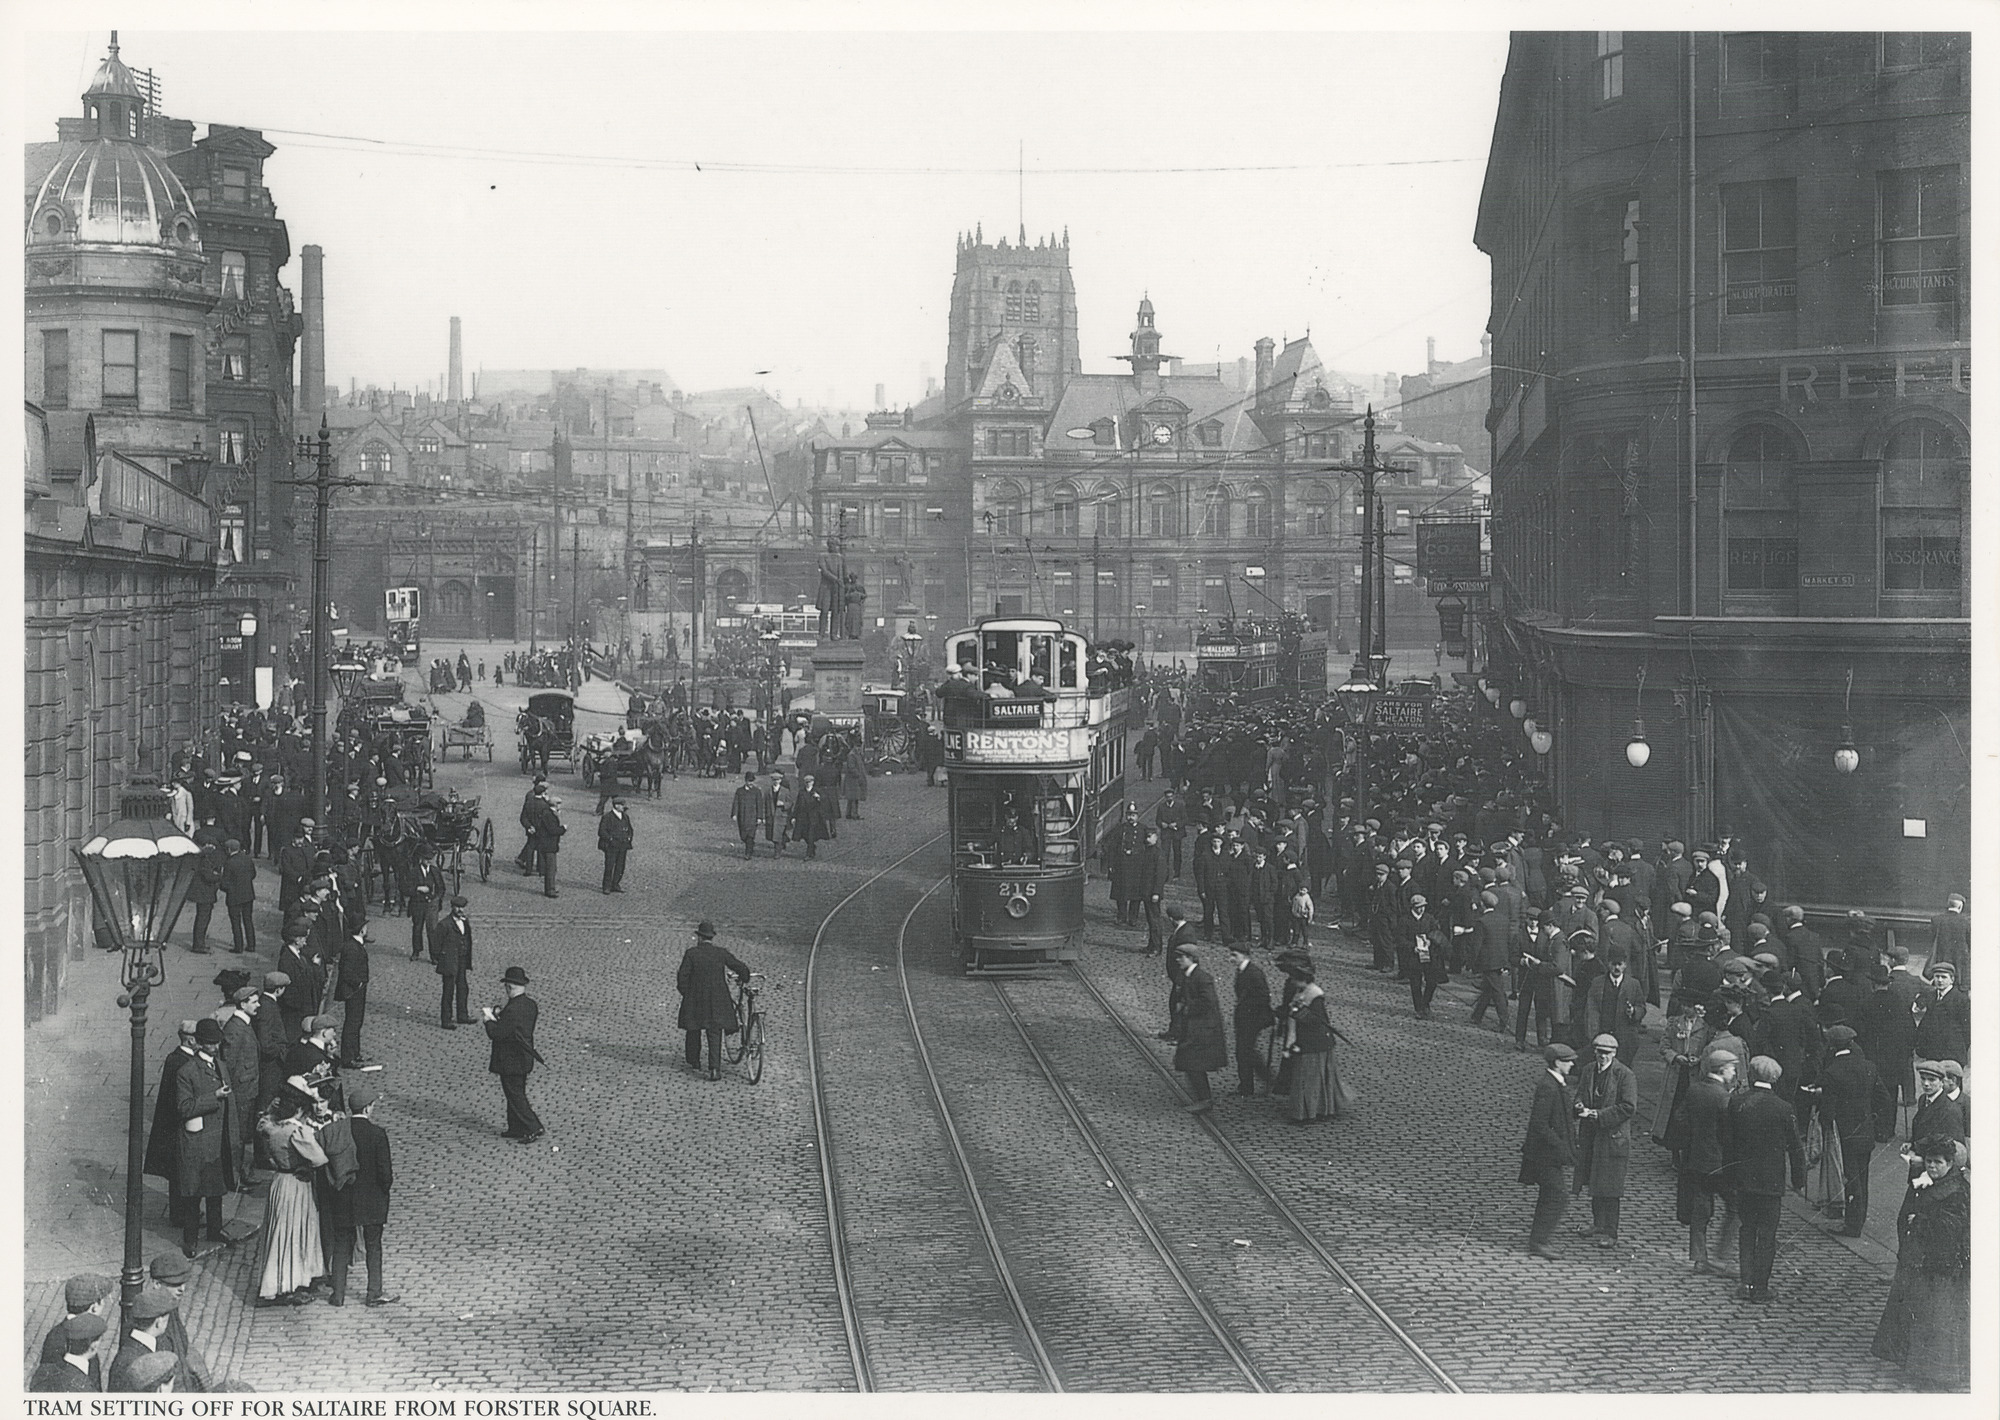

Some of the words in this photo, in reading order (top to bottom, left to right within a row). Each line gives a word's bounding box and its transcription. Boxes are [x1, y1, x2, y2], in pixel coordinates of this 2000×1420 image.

[1728, 284, 1796, 301] INCORPORATED
[215, 290, 257, 343] Hotel
[1804, 576, 1838, 585] MARKET
[993, 704, 1040, 716] SALTAIRE
[1374, 706, 1424, 718] SALTAIRE
[1385, 715, 1423, 723] HEATON
[966, 730, 1070, 750] RENTON'S
[999, 882, 1037, 897] 215
